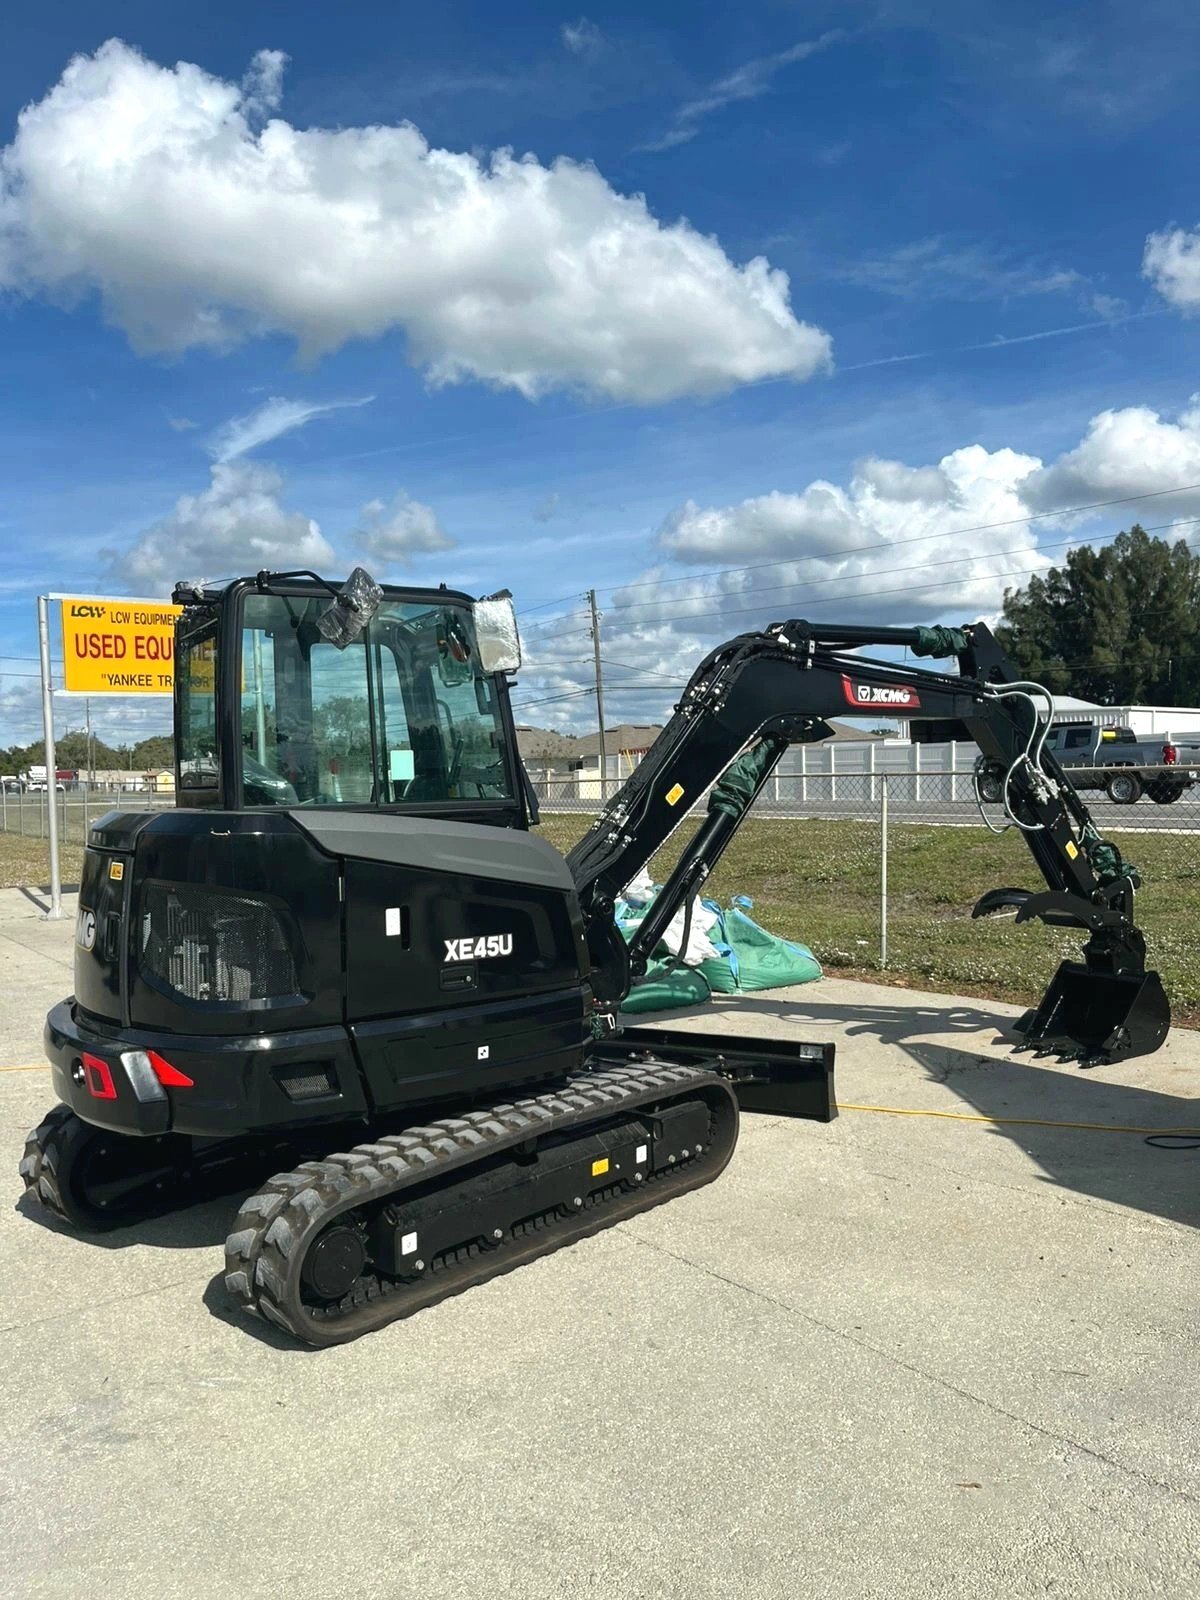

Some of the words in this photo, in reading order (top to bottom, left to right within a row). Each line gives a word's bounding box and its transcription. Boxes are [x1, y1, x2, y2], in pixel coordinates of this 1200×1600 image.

[71, 605, 105, 618] LCW
[110, 611, 130, 624] LCW
[75, 633, 126, 659] USED
[101, 673, 152, 687] "YANKEE
[871, 687, 911, 703] XCMG
[443, 933, 513, 962] XE45U
